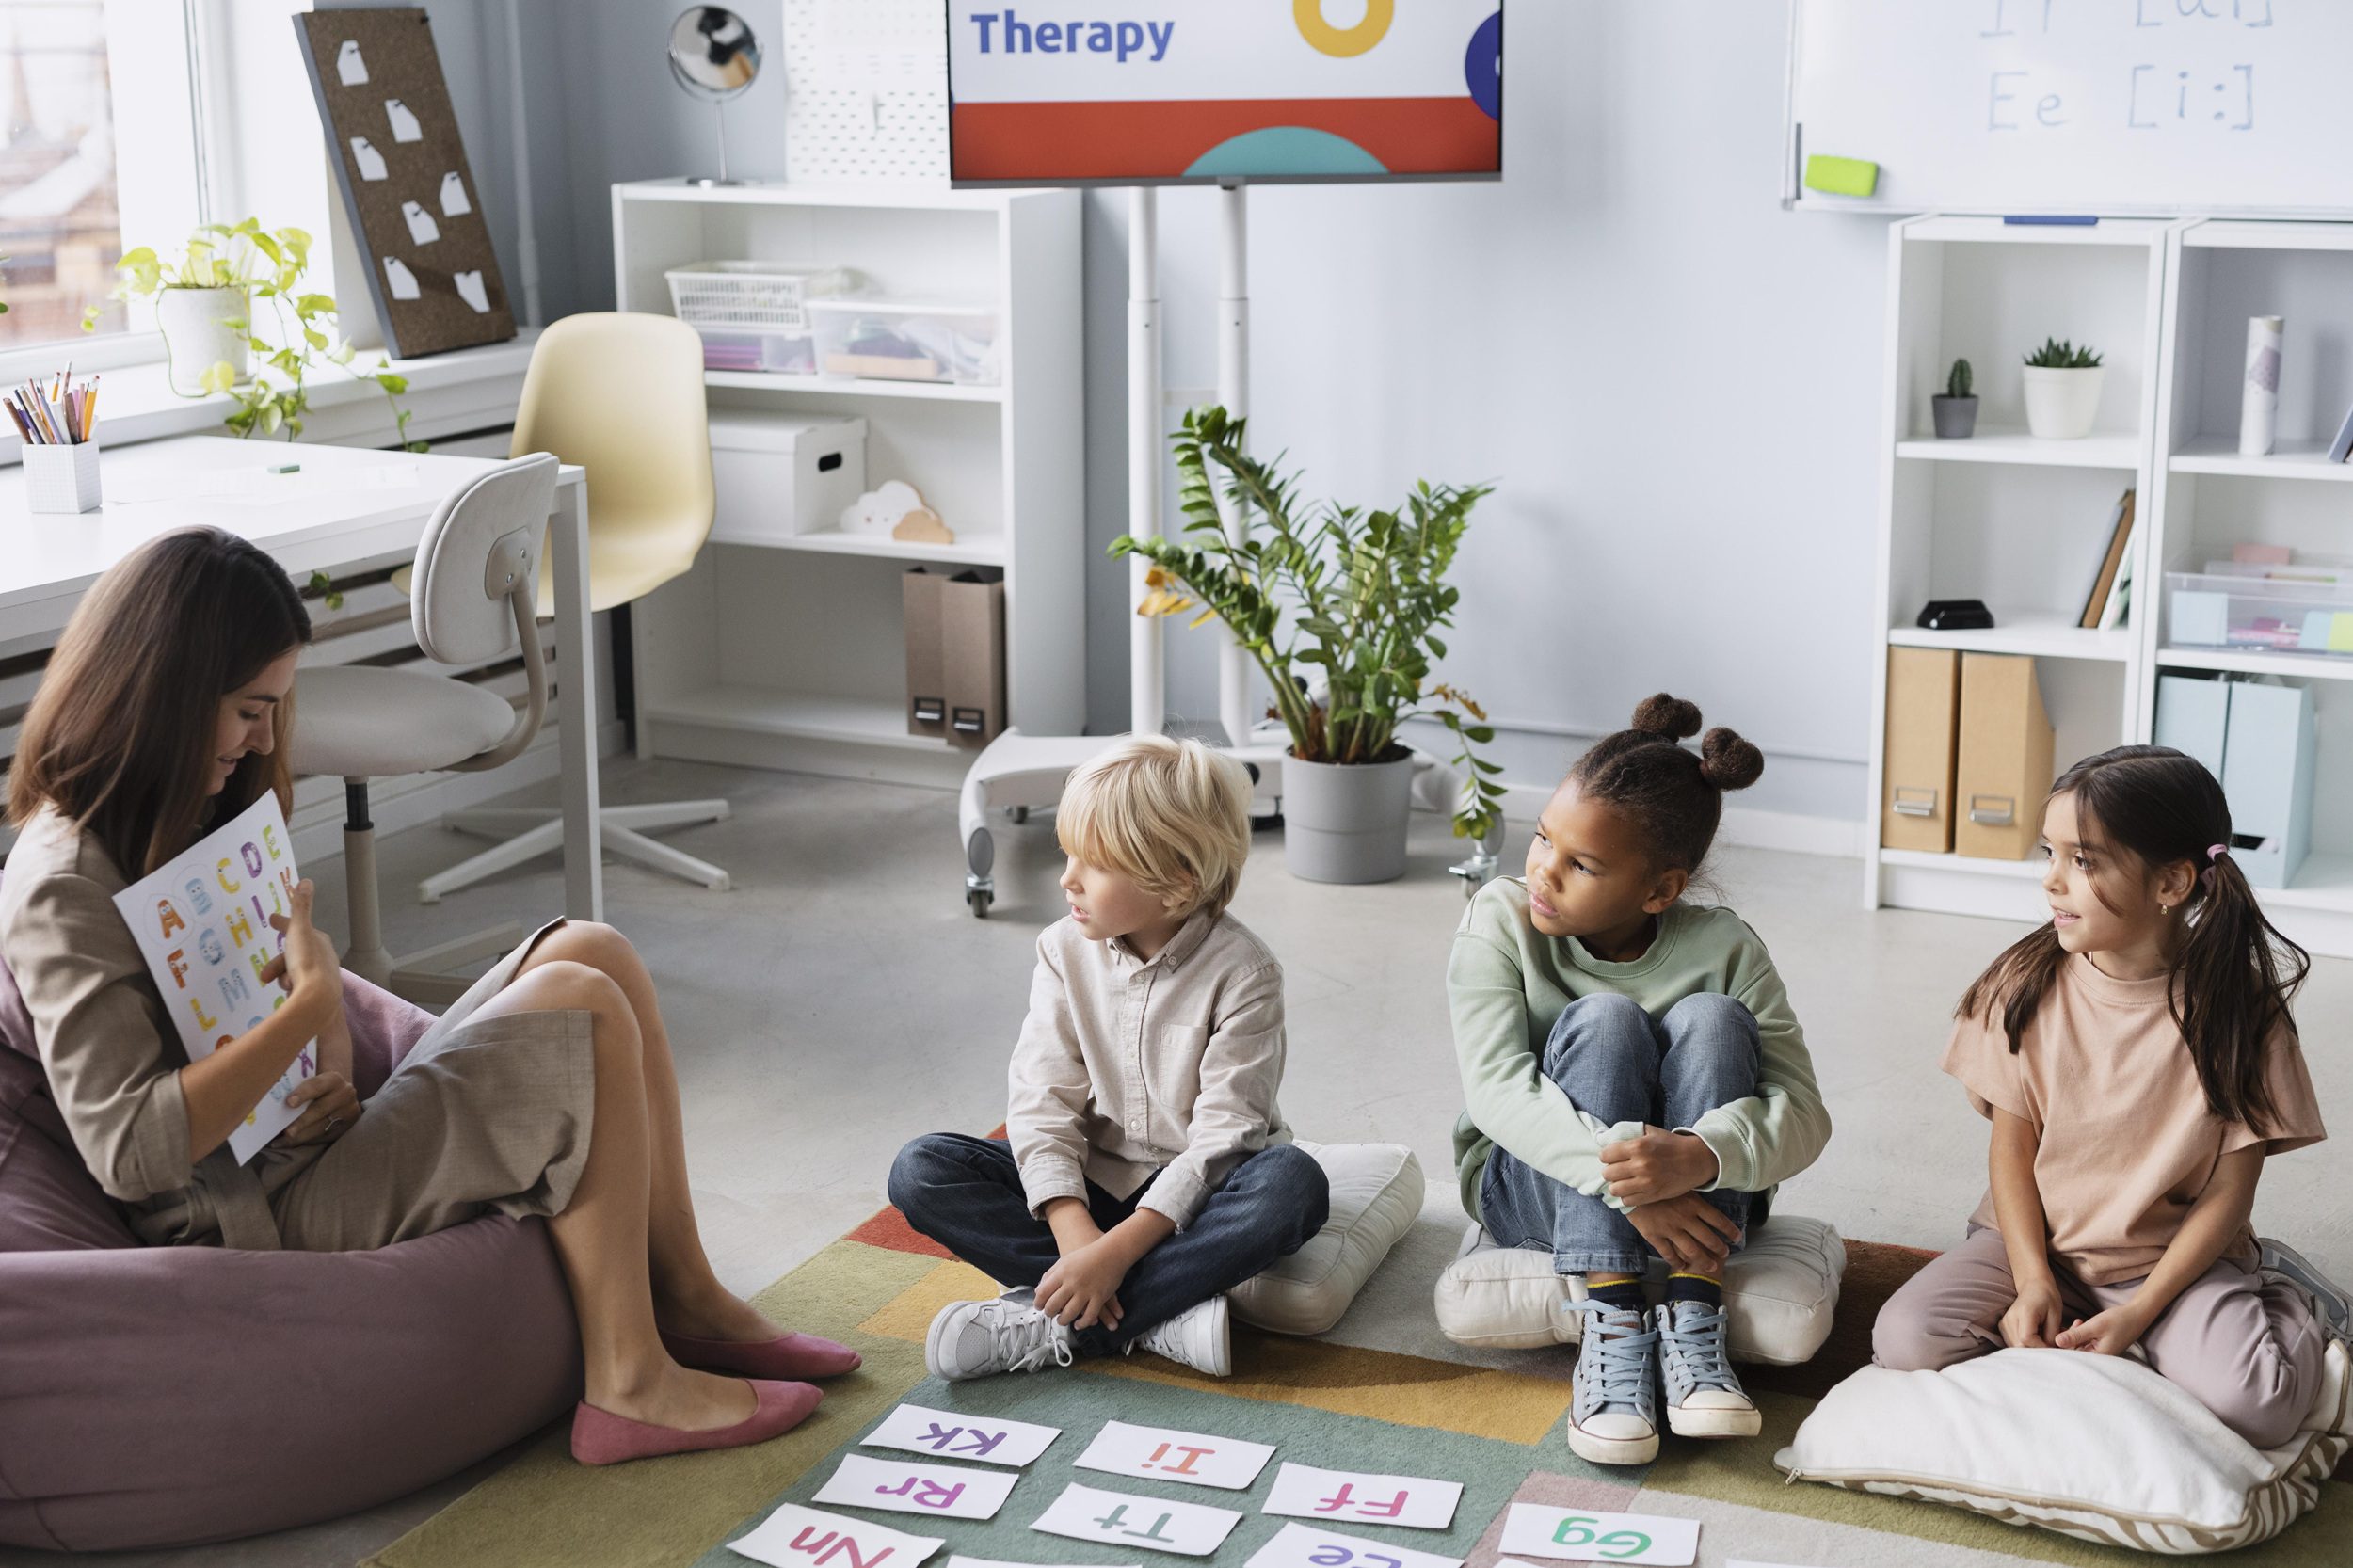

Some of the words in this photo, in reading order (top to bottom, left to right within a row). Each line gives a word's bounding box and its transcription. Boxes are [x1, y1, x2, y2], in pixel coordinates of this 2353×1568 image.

[970, 9, 1176, 63] Therapy
[1988, 72, 2071, 131] Ee
[157, 899, 185, 939] A
[184, 878, 213, 916] B
[217, 857, 240, 894] C
[241, 841, 263, 878] D
[263, 824, 280, 860] E
[168, 948, 189, 989] F
[199, 928, 225, 966] G
[226, 906, 254, 948] H
[251, 895, 268, 929] I
[190, 997, 217, 1032] L
[218, 968, 251, 1013] M
[917, 1422, 1007, 1455] Kk
[1141, 1443, 1215, 1475] Ii
[875, 1477, 966, 1508] Rr
[1314, 1483, 1409, 1517] Ff
[1093, 1504, 1174, 1543] Tt
[1551, 1516, 1652, 1558] Gg
